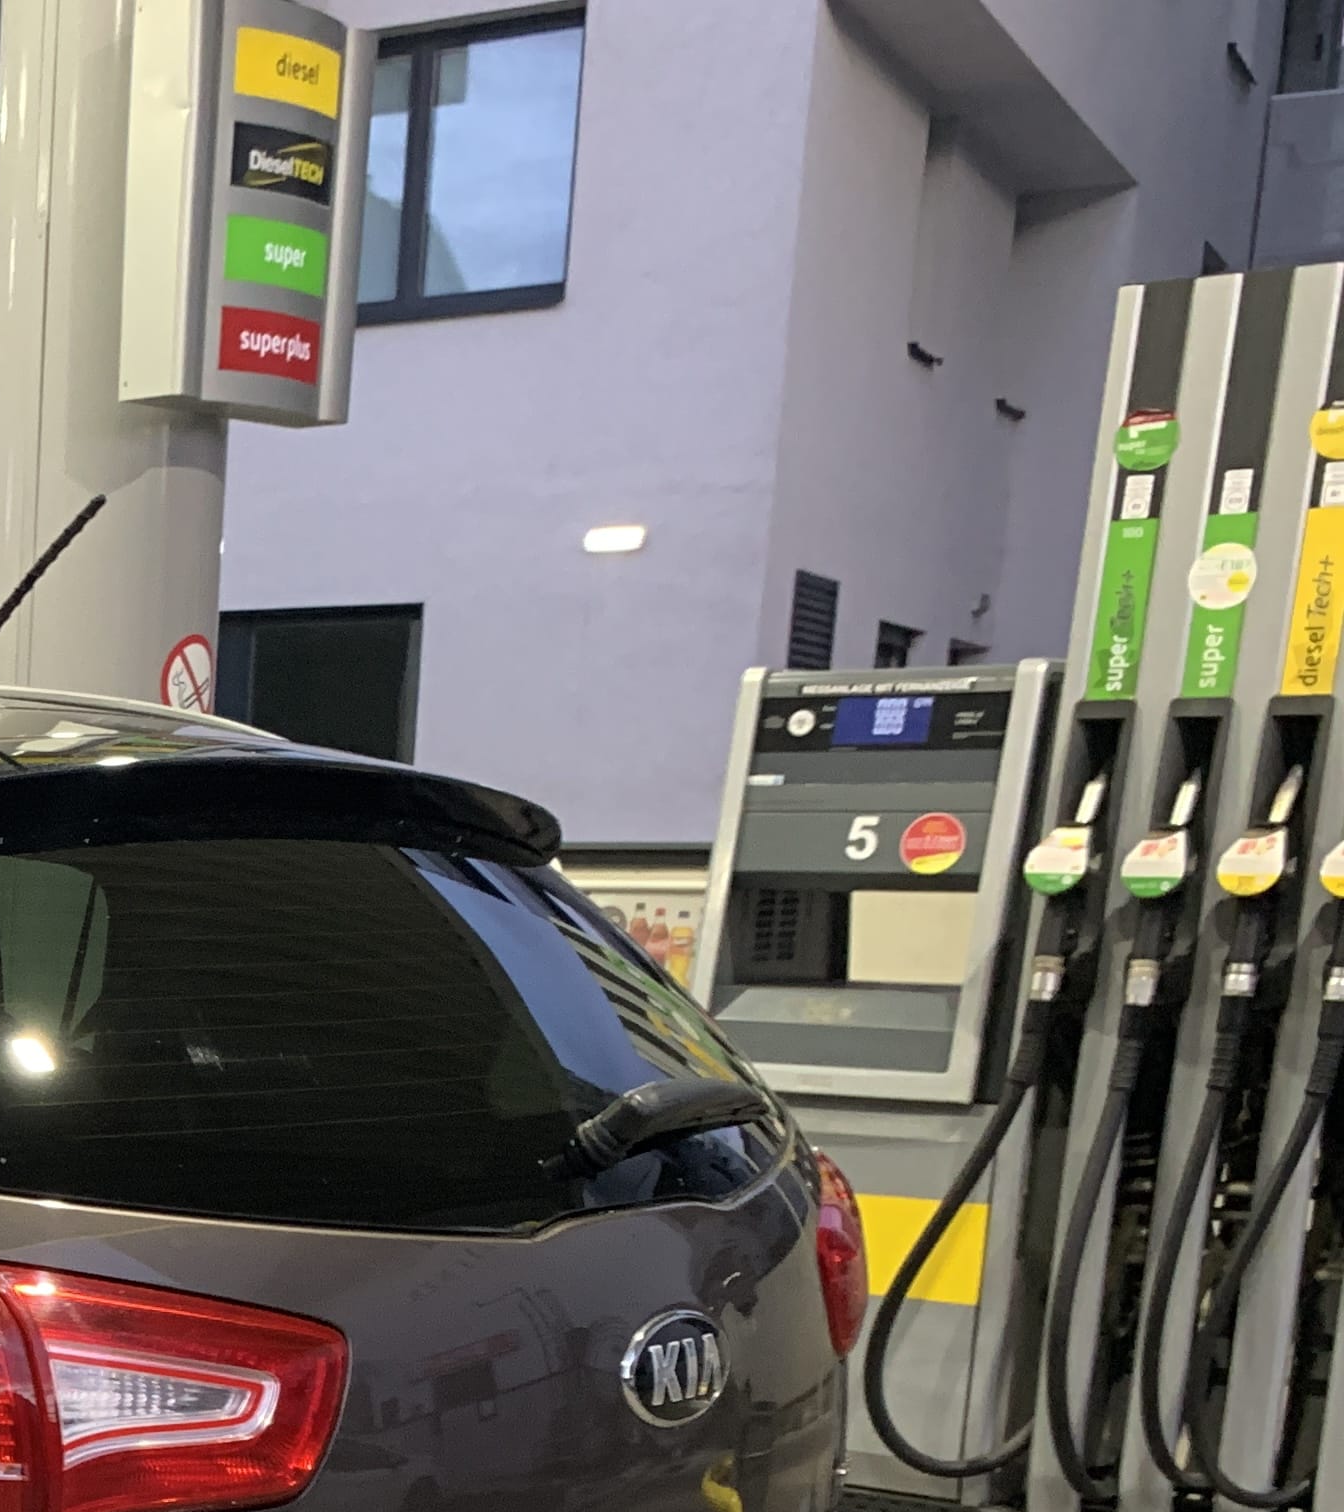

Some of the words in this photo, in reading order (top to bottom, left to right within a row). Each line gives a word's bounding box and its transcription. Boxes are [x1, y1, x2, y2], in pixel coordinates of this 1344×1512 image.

[275, 52, 320, 85] diesel
[264, 241, 307, 271] super
[239, 329, 312, 363] superplus
[1306, 555, 1334, 618] Tech+
[1105, 635, 1130, 692] super
[1198, 624, 1226, 689] super
[1297, 626, 1325, 687] diesel
[845, 816, 880, 860] 5
[648, 1333, 723, 1406] KIA
